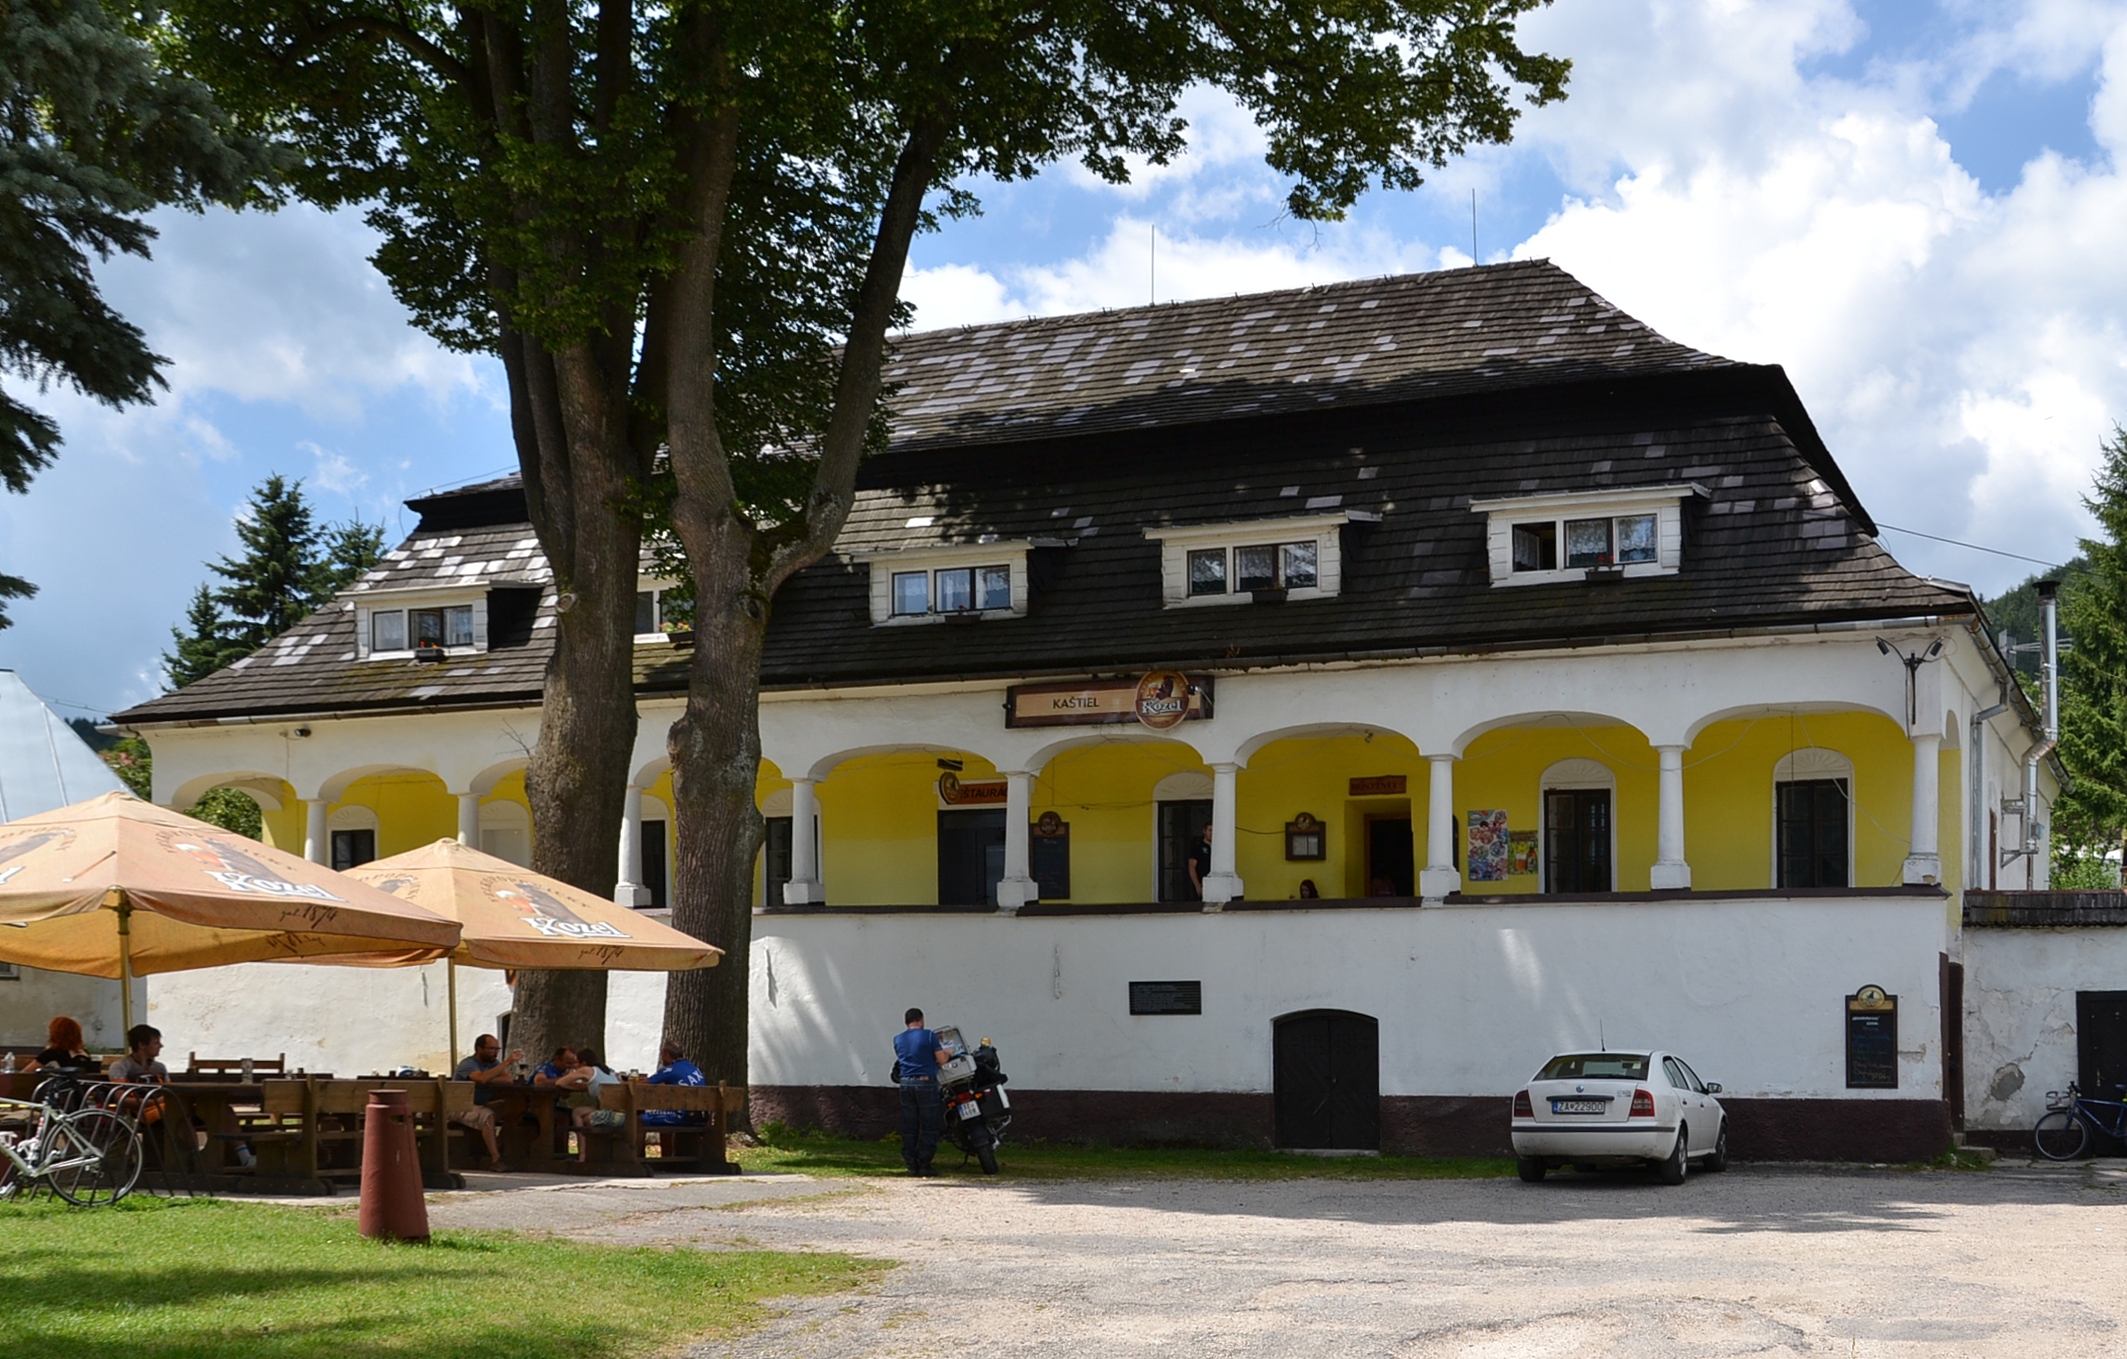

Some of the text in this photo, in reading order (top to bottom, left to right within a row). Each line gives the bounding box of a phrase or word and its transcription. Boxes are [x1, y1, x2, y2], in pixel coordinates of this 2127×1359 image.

[1052, 697, 1099, 709] KAŠTIEL
[1141, 699, 1183, 714] Kozel
[204, 870, 350, 902] Kozel
[302, 905, 338, 929] 1874
[520, 917, 632, 938] Kozel
[678, 1067, 704, 1086] SAX
